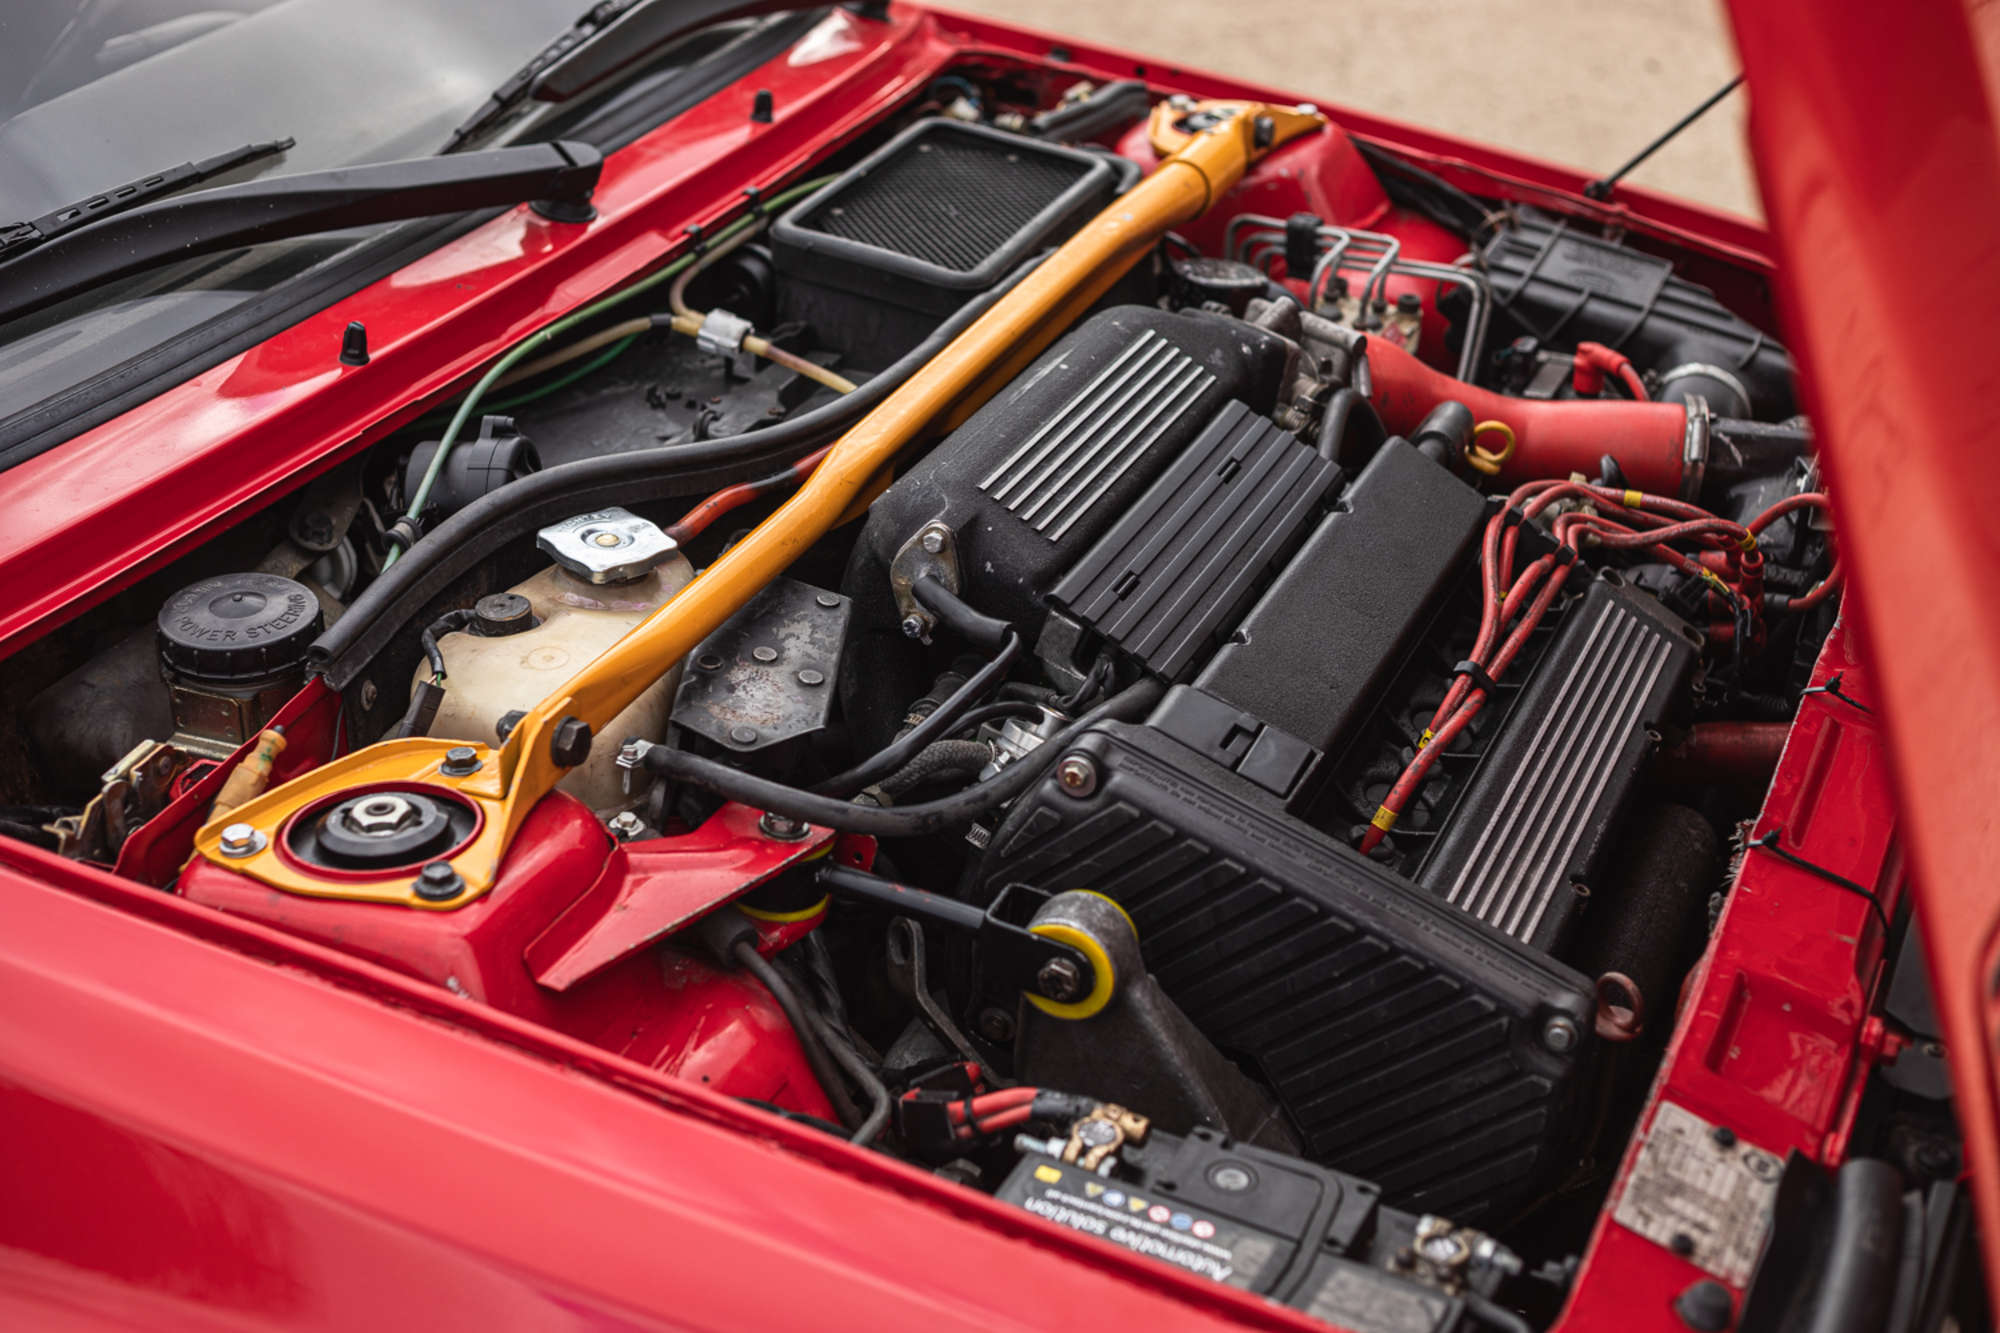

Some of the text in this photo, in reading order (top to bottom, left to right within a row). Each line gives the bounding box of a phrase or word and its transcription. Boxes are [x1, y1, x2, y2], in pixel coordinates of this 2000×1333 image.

[176, 616, 238, 642] POWER
[247, 593, 307, 639] STEERING
[1024, 1196, 1108, 1235] solution
[1110, 1226, 1232, 1282] Automotive
